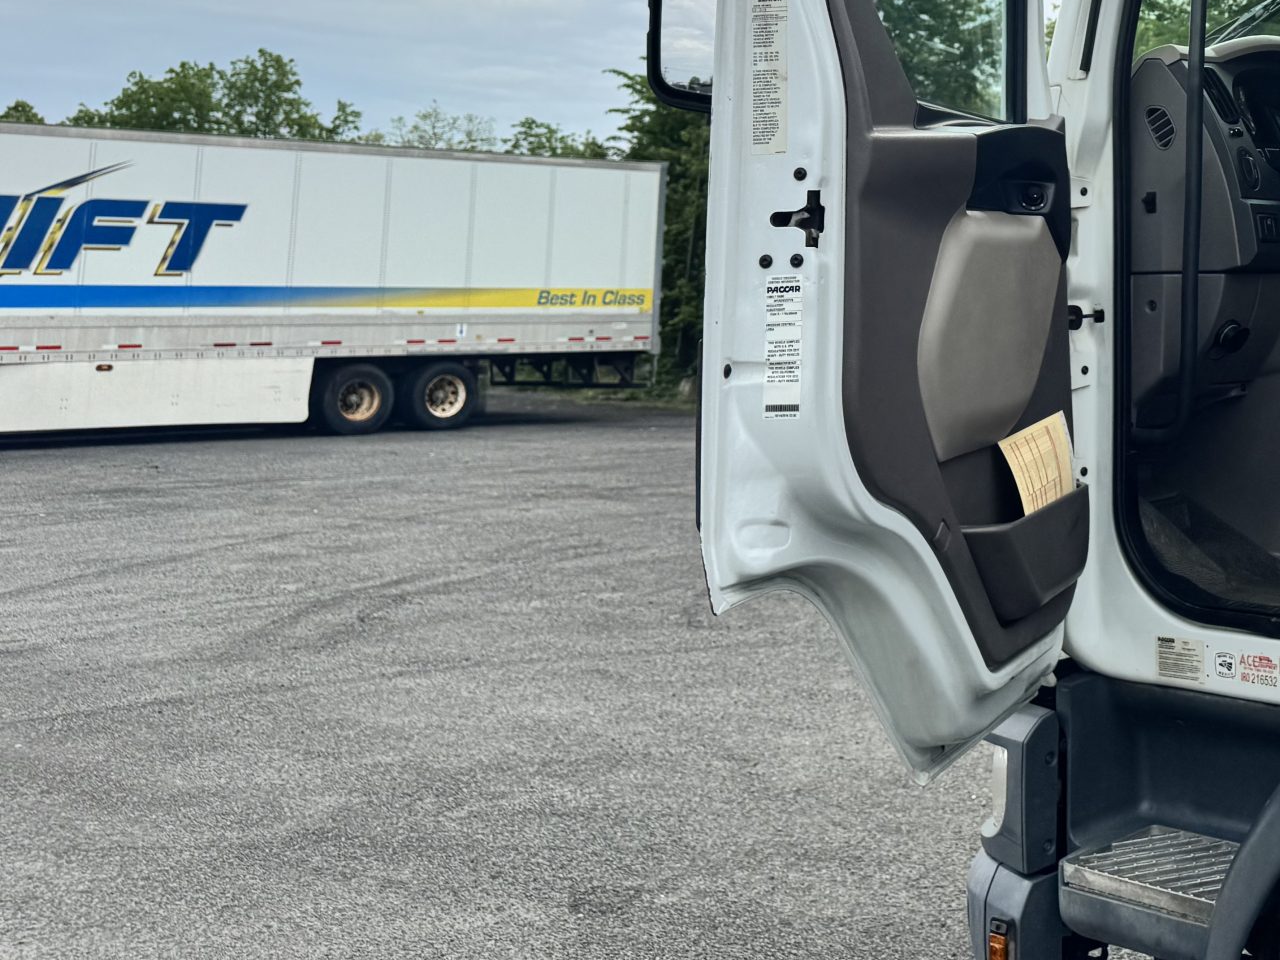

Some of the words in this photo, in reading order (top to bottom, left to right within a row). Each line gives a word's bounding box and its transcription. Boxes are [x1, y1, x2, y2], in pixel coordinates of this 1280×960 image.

[0, 194, 249, 275] IFT
[766, 285, 801, 294] PACCAR
[537, 290, 577, 305] Best
[581, 290, 597, 305] In
[602, 290, 646, 305] Class
[1251, 673, 1278, 687] 216532
